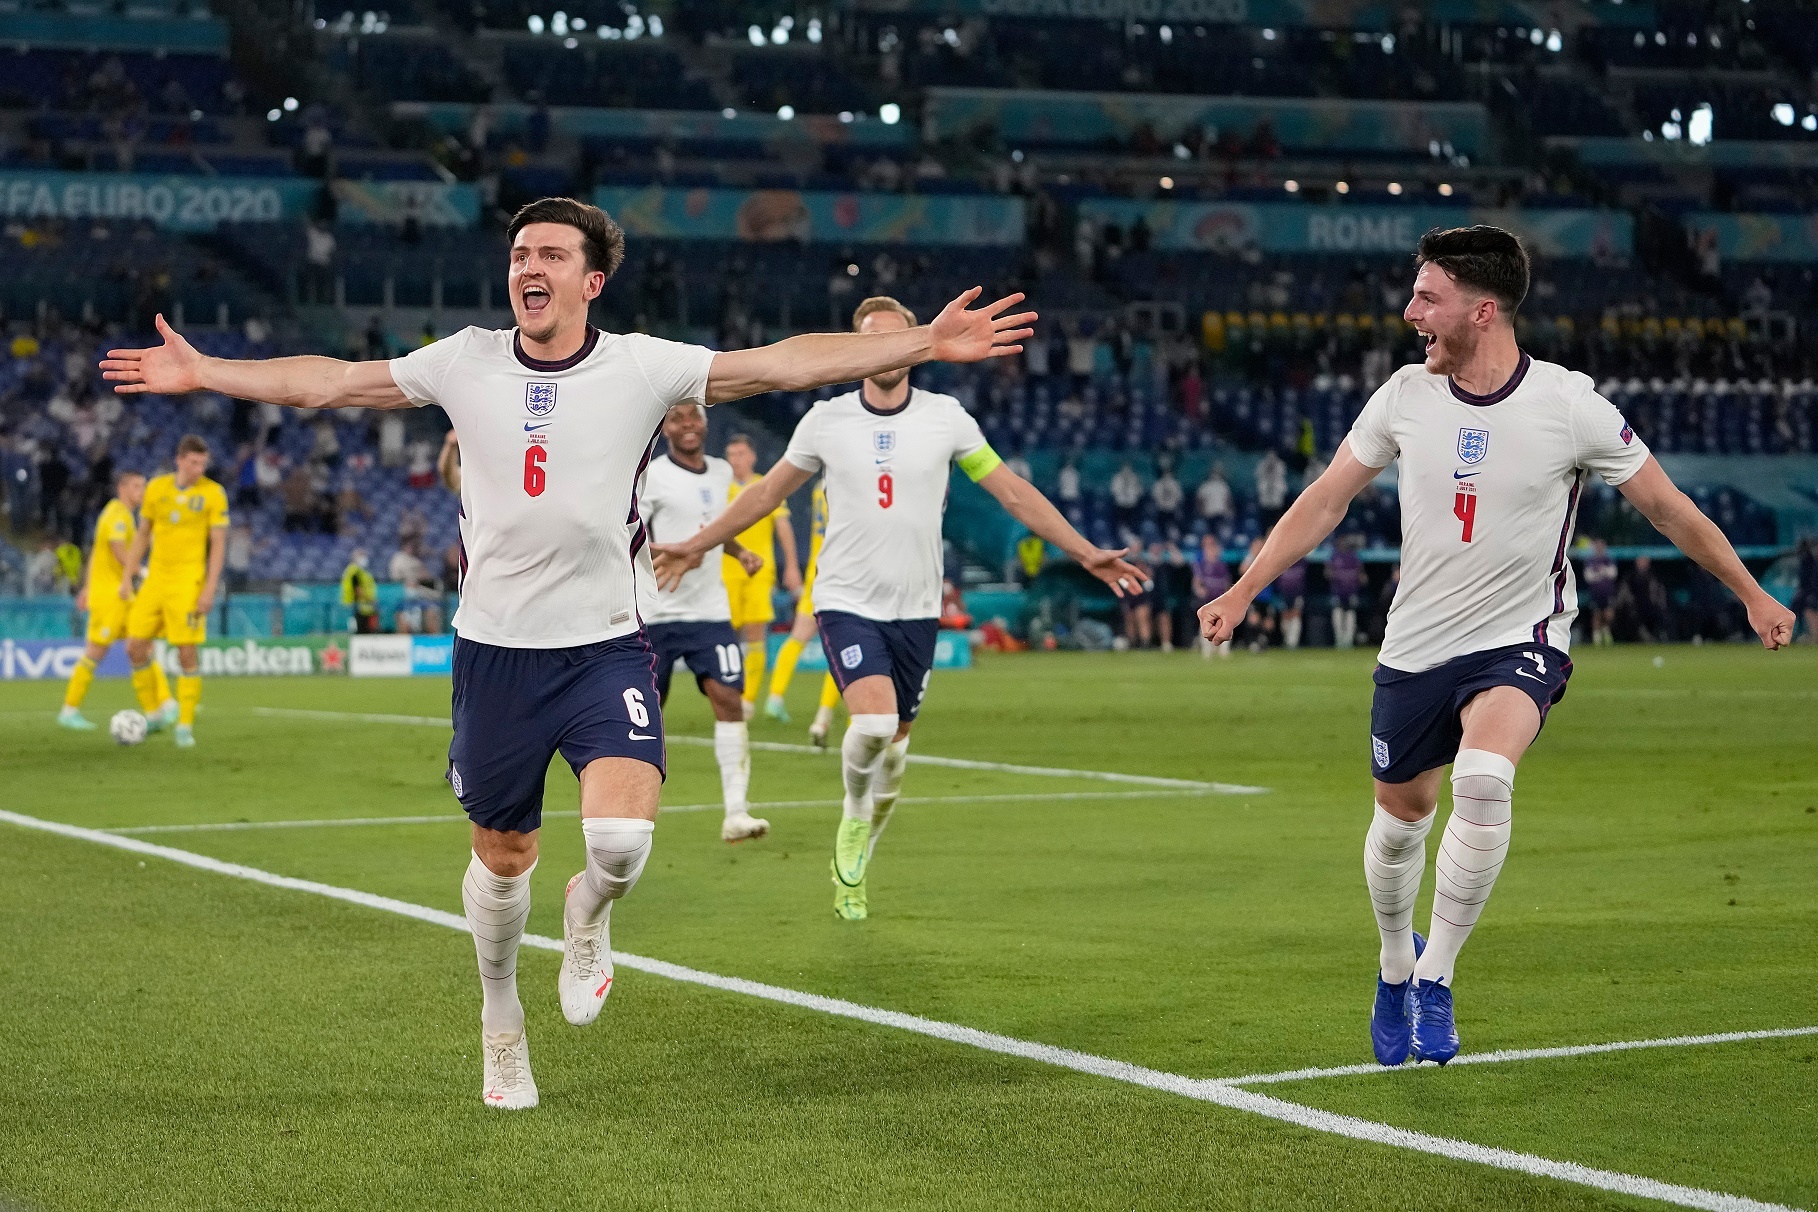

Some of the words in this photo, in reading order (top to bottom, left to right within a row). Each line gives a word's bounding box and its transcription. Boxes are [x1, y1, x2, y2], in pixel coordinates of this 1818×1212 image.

[62, 181, 175, 222] EURO
[178, 185, 281, 221] 2020
[1308, 214, 1413, 248] ROME
[524, 445, 547, 497] 6
[878, 473, 893, 509] 9
[1454, 493, 1477, 543] 4
[715, 644, 742, 673] 10
[1522, 651, 1547, 675] 4
[622, 687, 650, 728] 6
